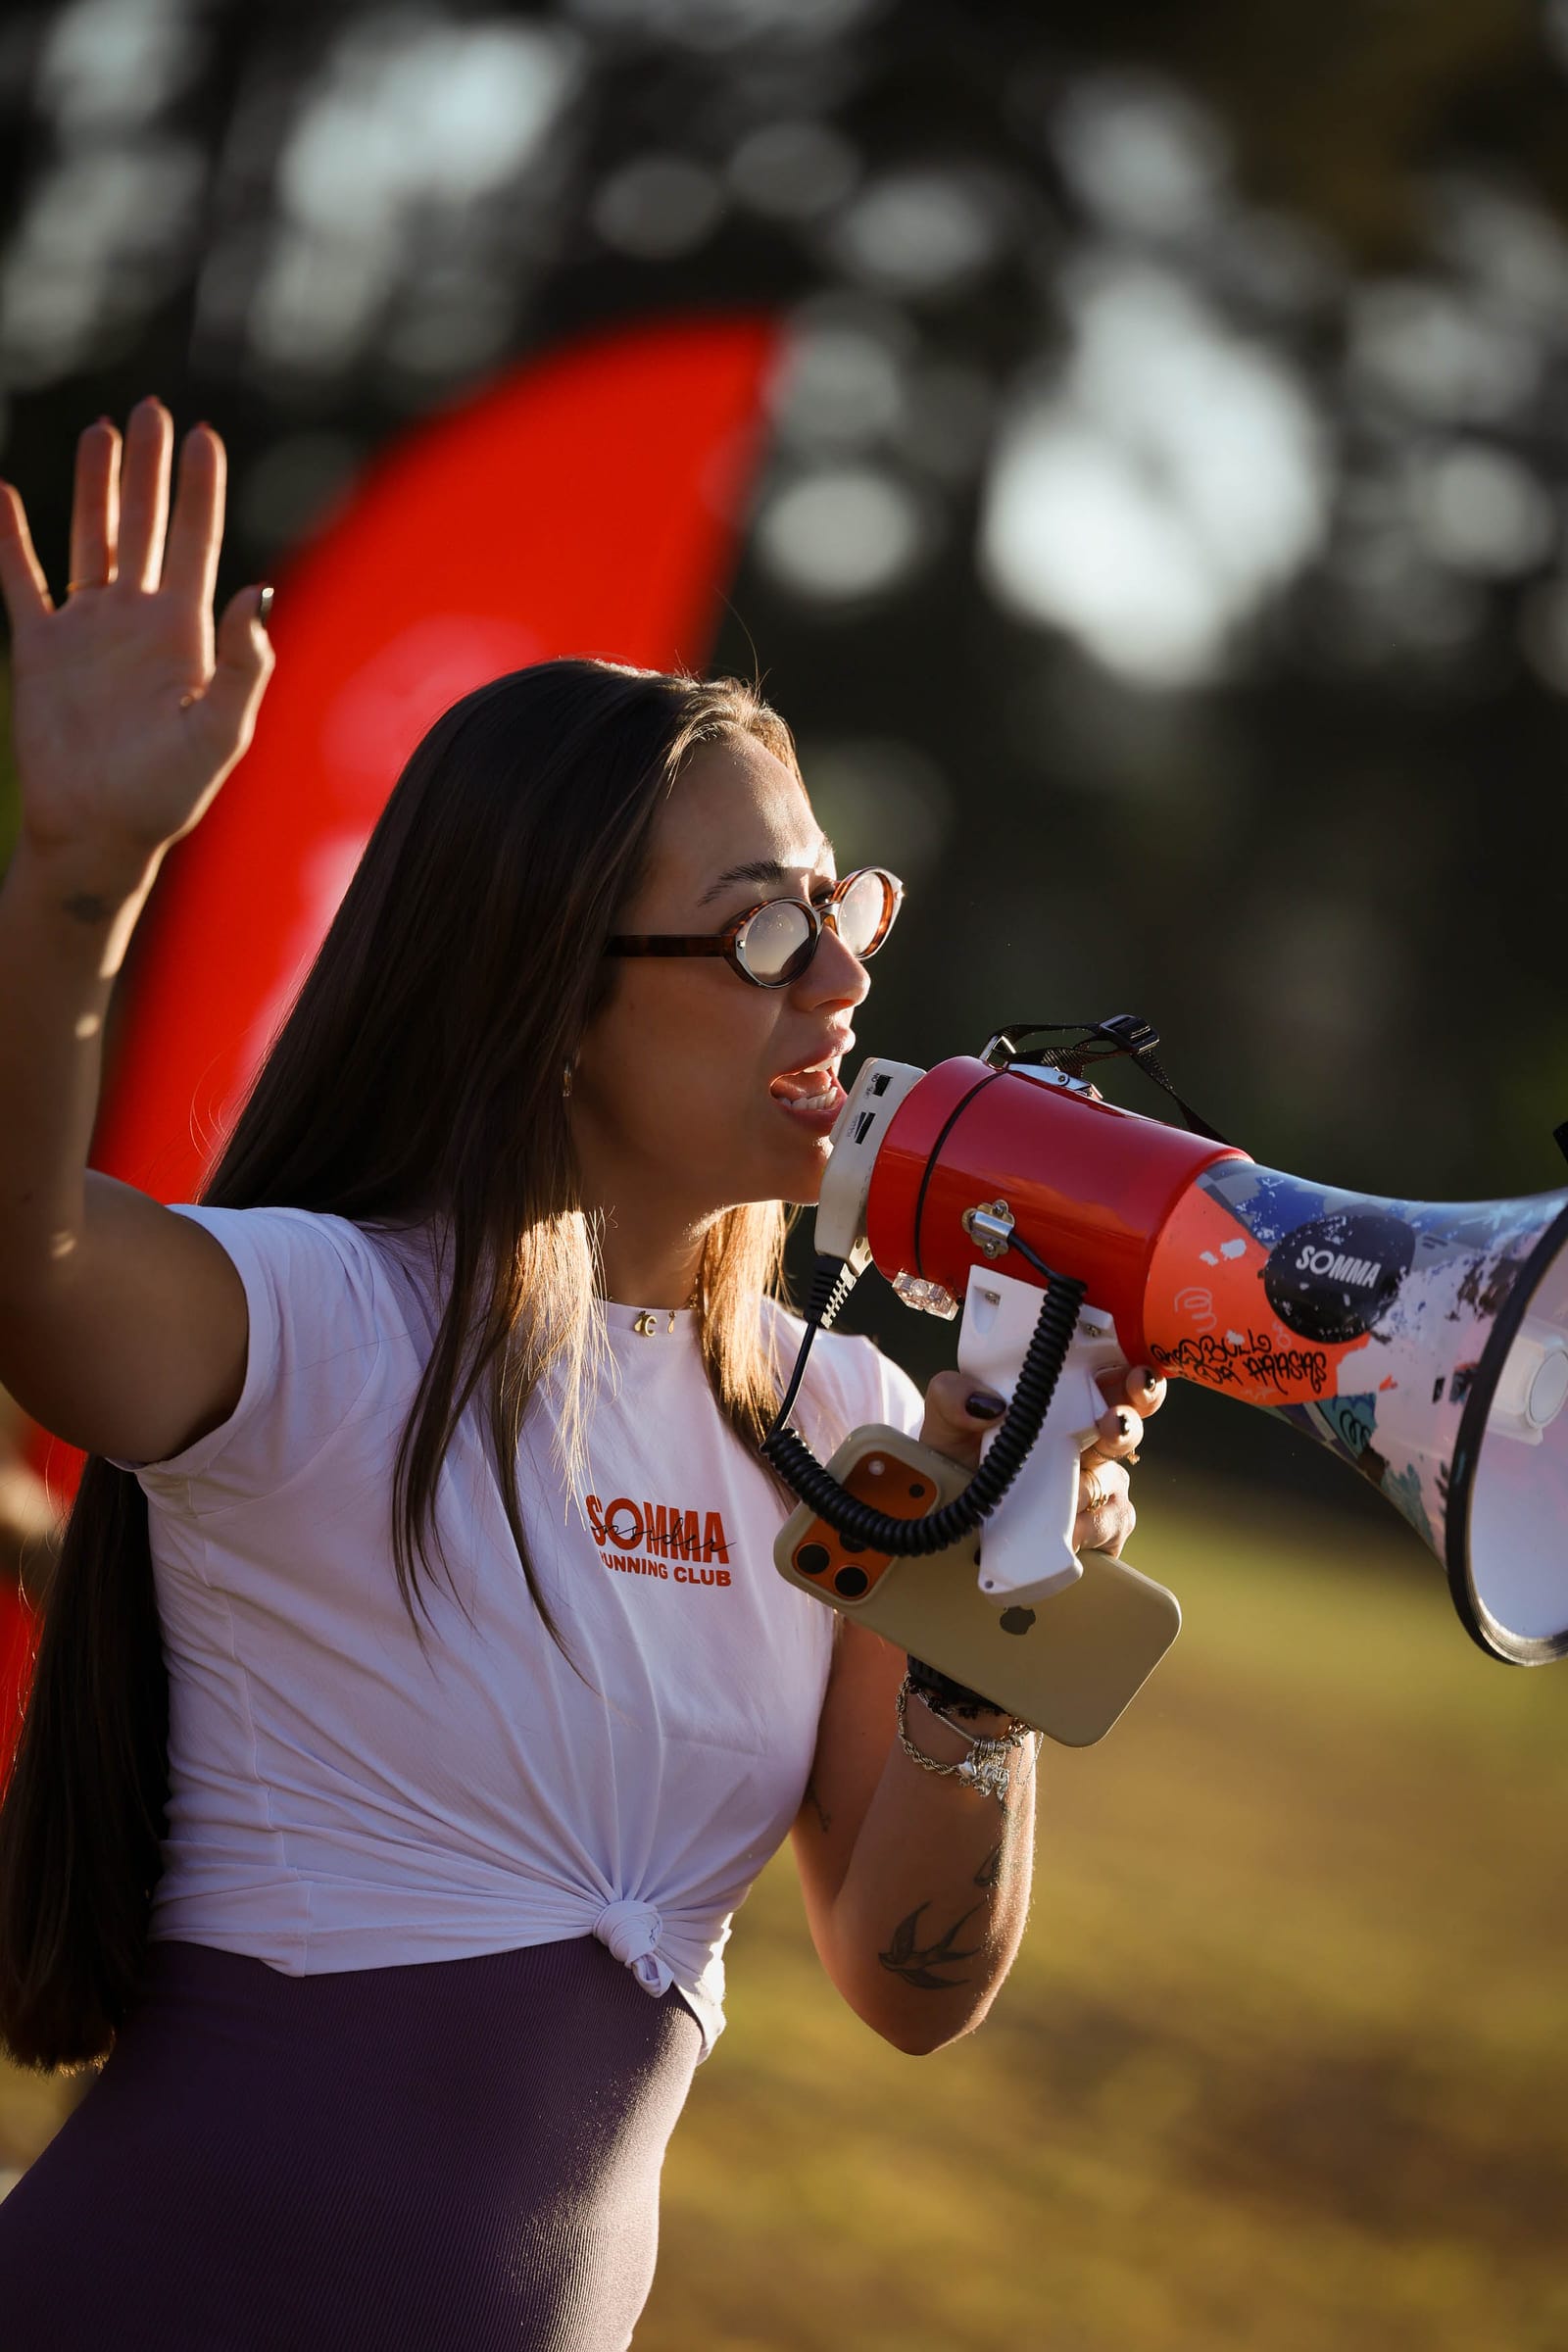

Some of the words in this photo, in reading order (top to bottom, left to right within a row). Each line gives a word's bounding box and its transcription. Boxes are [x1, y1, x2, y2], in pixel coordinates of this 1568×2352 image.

[1296, 1245, 1382, 1289] SOMMA
[585, 1494, 730, 1564] SOMMA
[673, 1566, 732, 1587] CLUB
